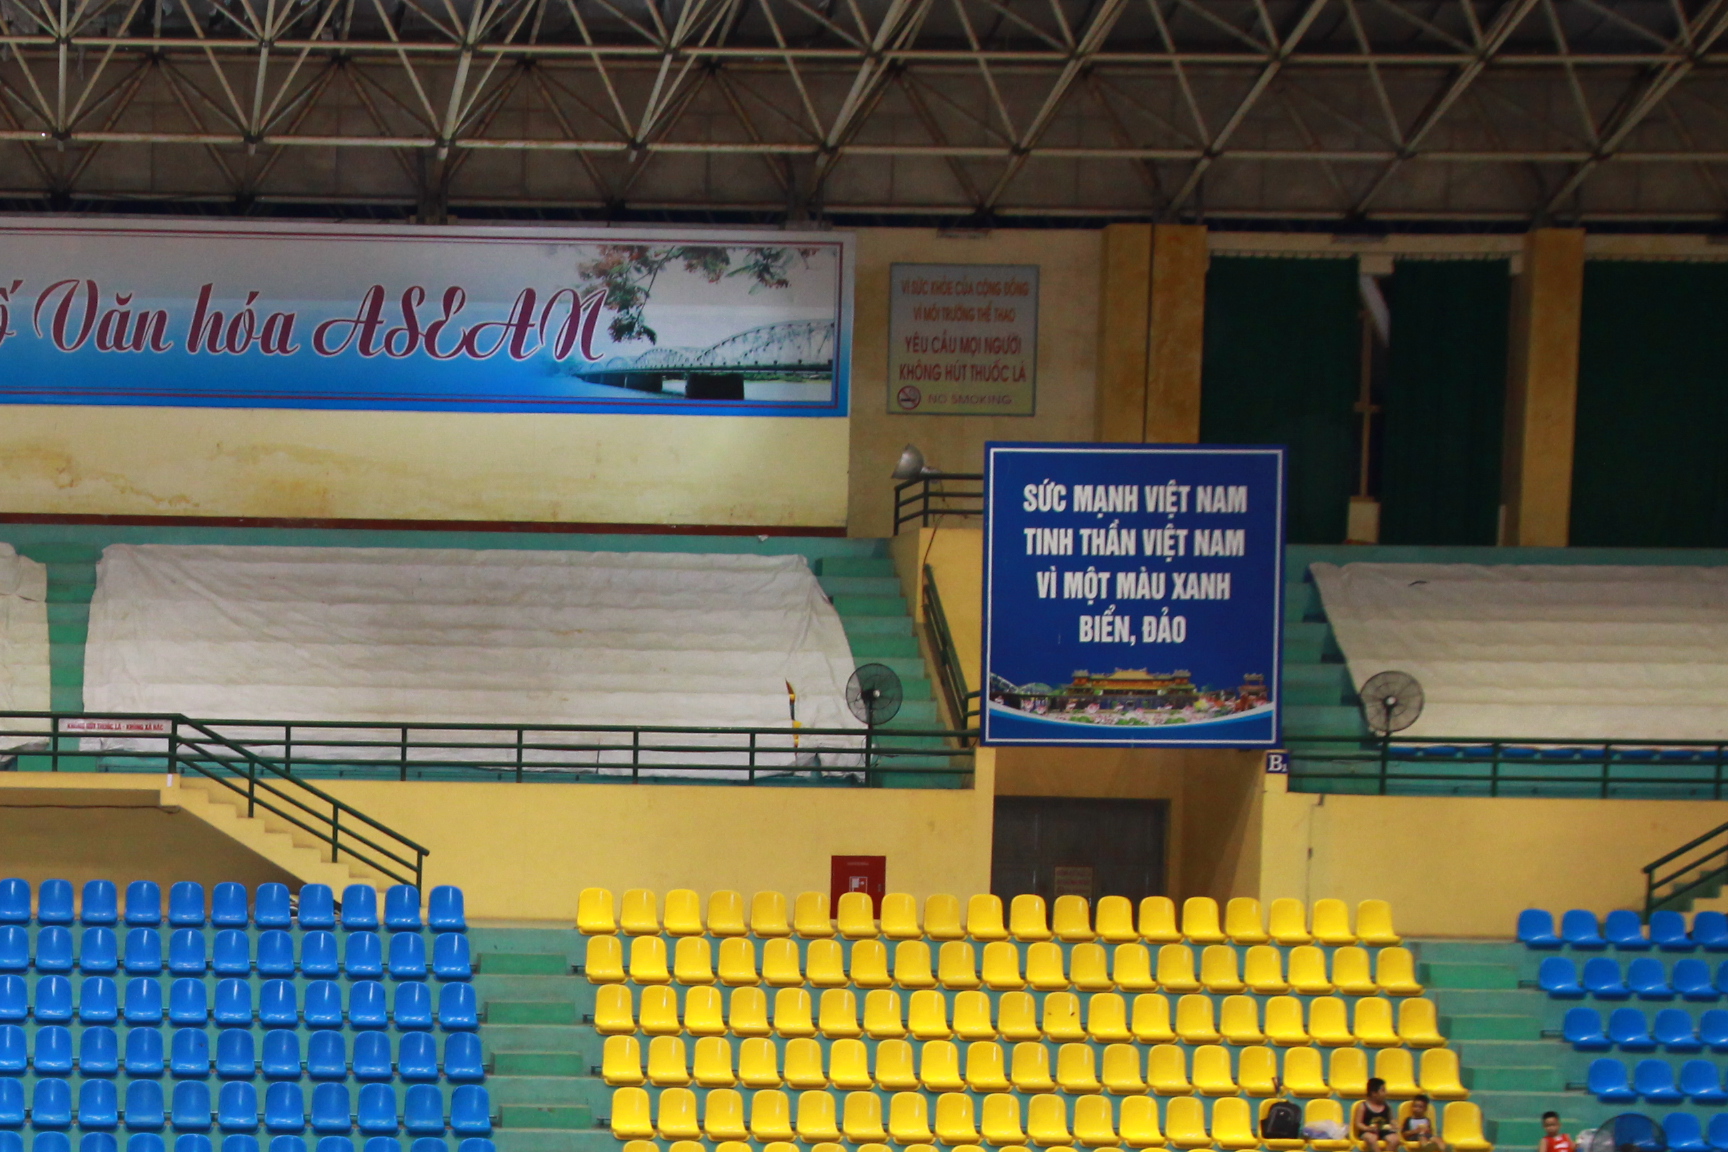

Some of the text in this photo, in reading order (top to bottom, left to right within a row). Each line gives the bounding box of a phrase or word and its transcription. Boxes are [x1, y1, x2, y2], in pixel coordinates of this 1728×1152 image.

[33, 278, 174, 355] Văn
[186, 283, 300, 356] hóa
[312, 284, 611, 361] ASEAN
[900, 359, 1026, 382] KHÔNG HÚT THUỐC LÁ
[928, 394, 1012, 404] NO SMOKING
[1023, 478, 1248, 519] SỨC MẠNH VIỆT NAM
[1024, 519, 1245, 562] TINH THẦN VIỆT NAM
[1036, 566, 1231, 605] VÌ MỘT MÀU XANH
[1079, 604, 1186, 646] BIỂN, ĐẢO
